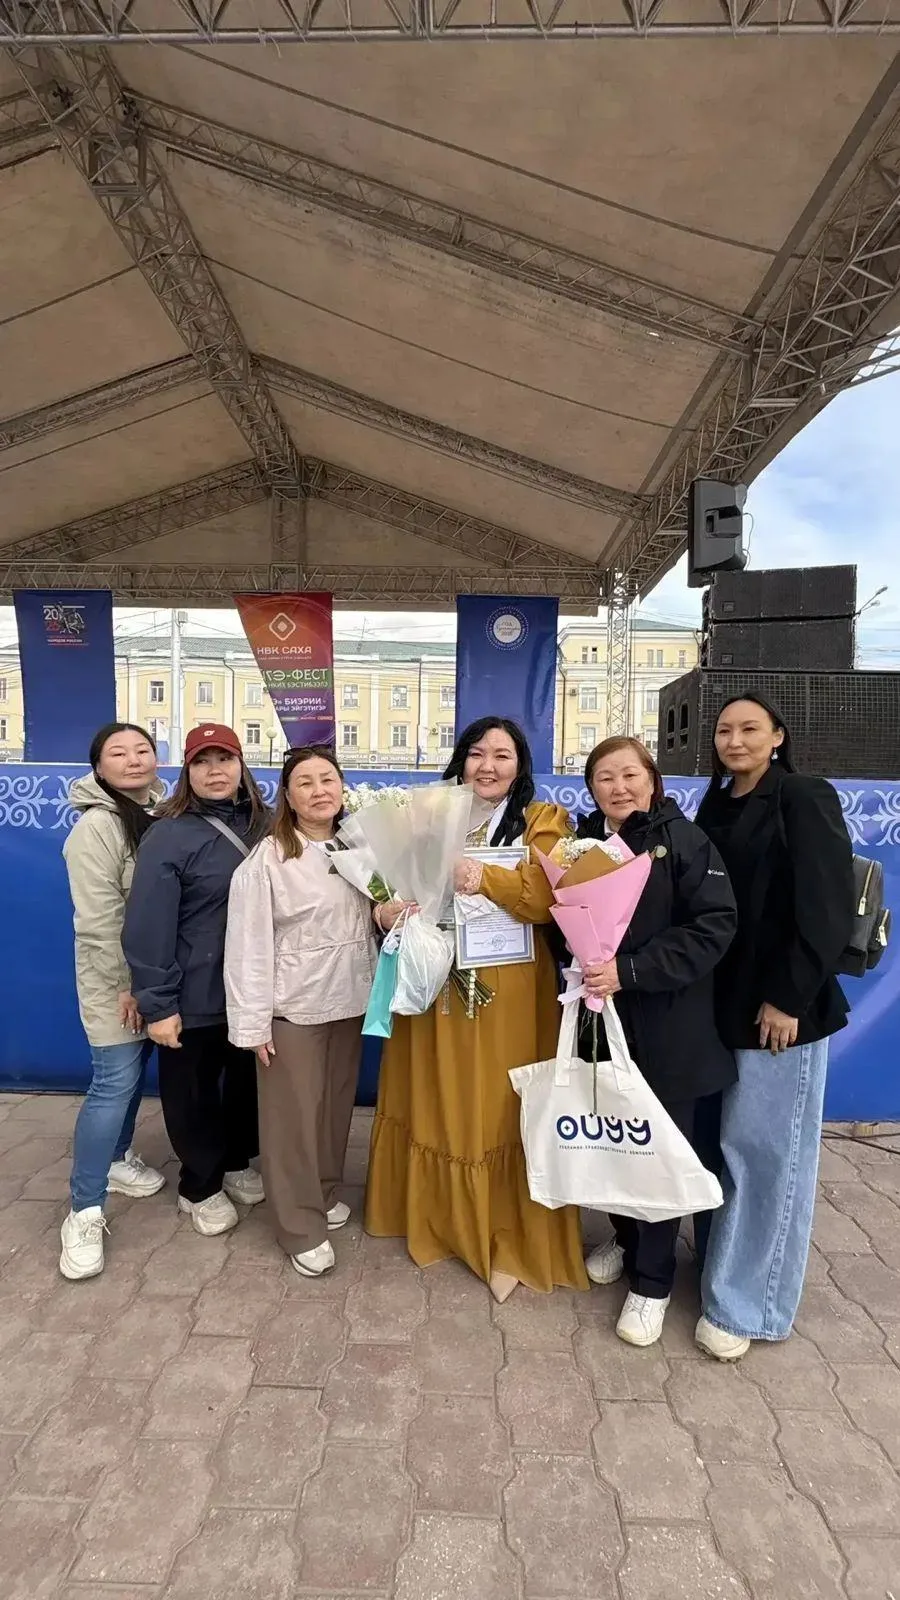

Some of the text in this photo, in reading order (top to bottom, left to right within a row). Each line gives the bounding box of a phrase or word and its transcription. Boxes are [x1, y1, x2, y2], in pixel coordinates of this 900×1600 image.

[43, 608, 59, 620] 20
[257, 646, 312, 655] НВК САХА
[284, 697, 321, 705] БИЭРИИ
